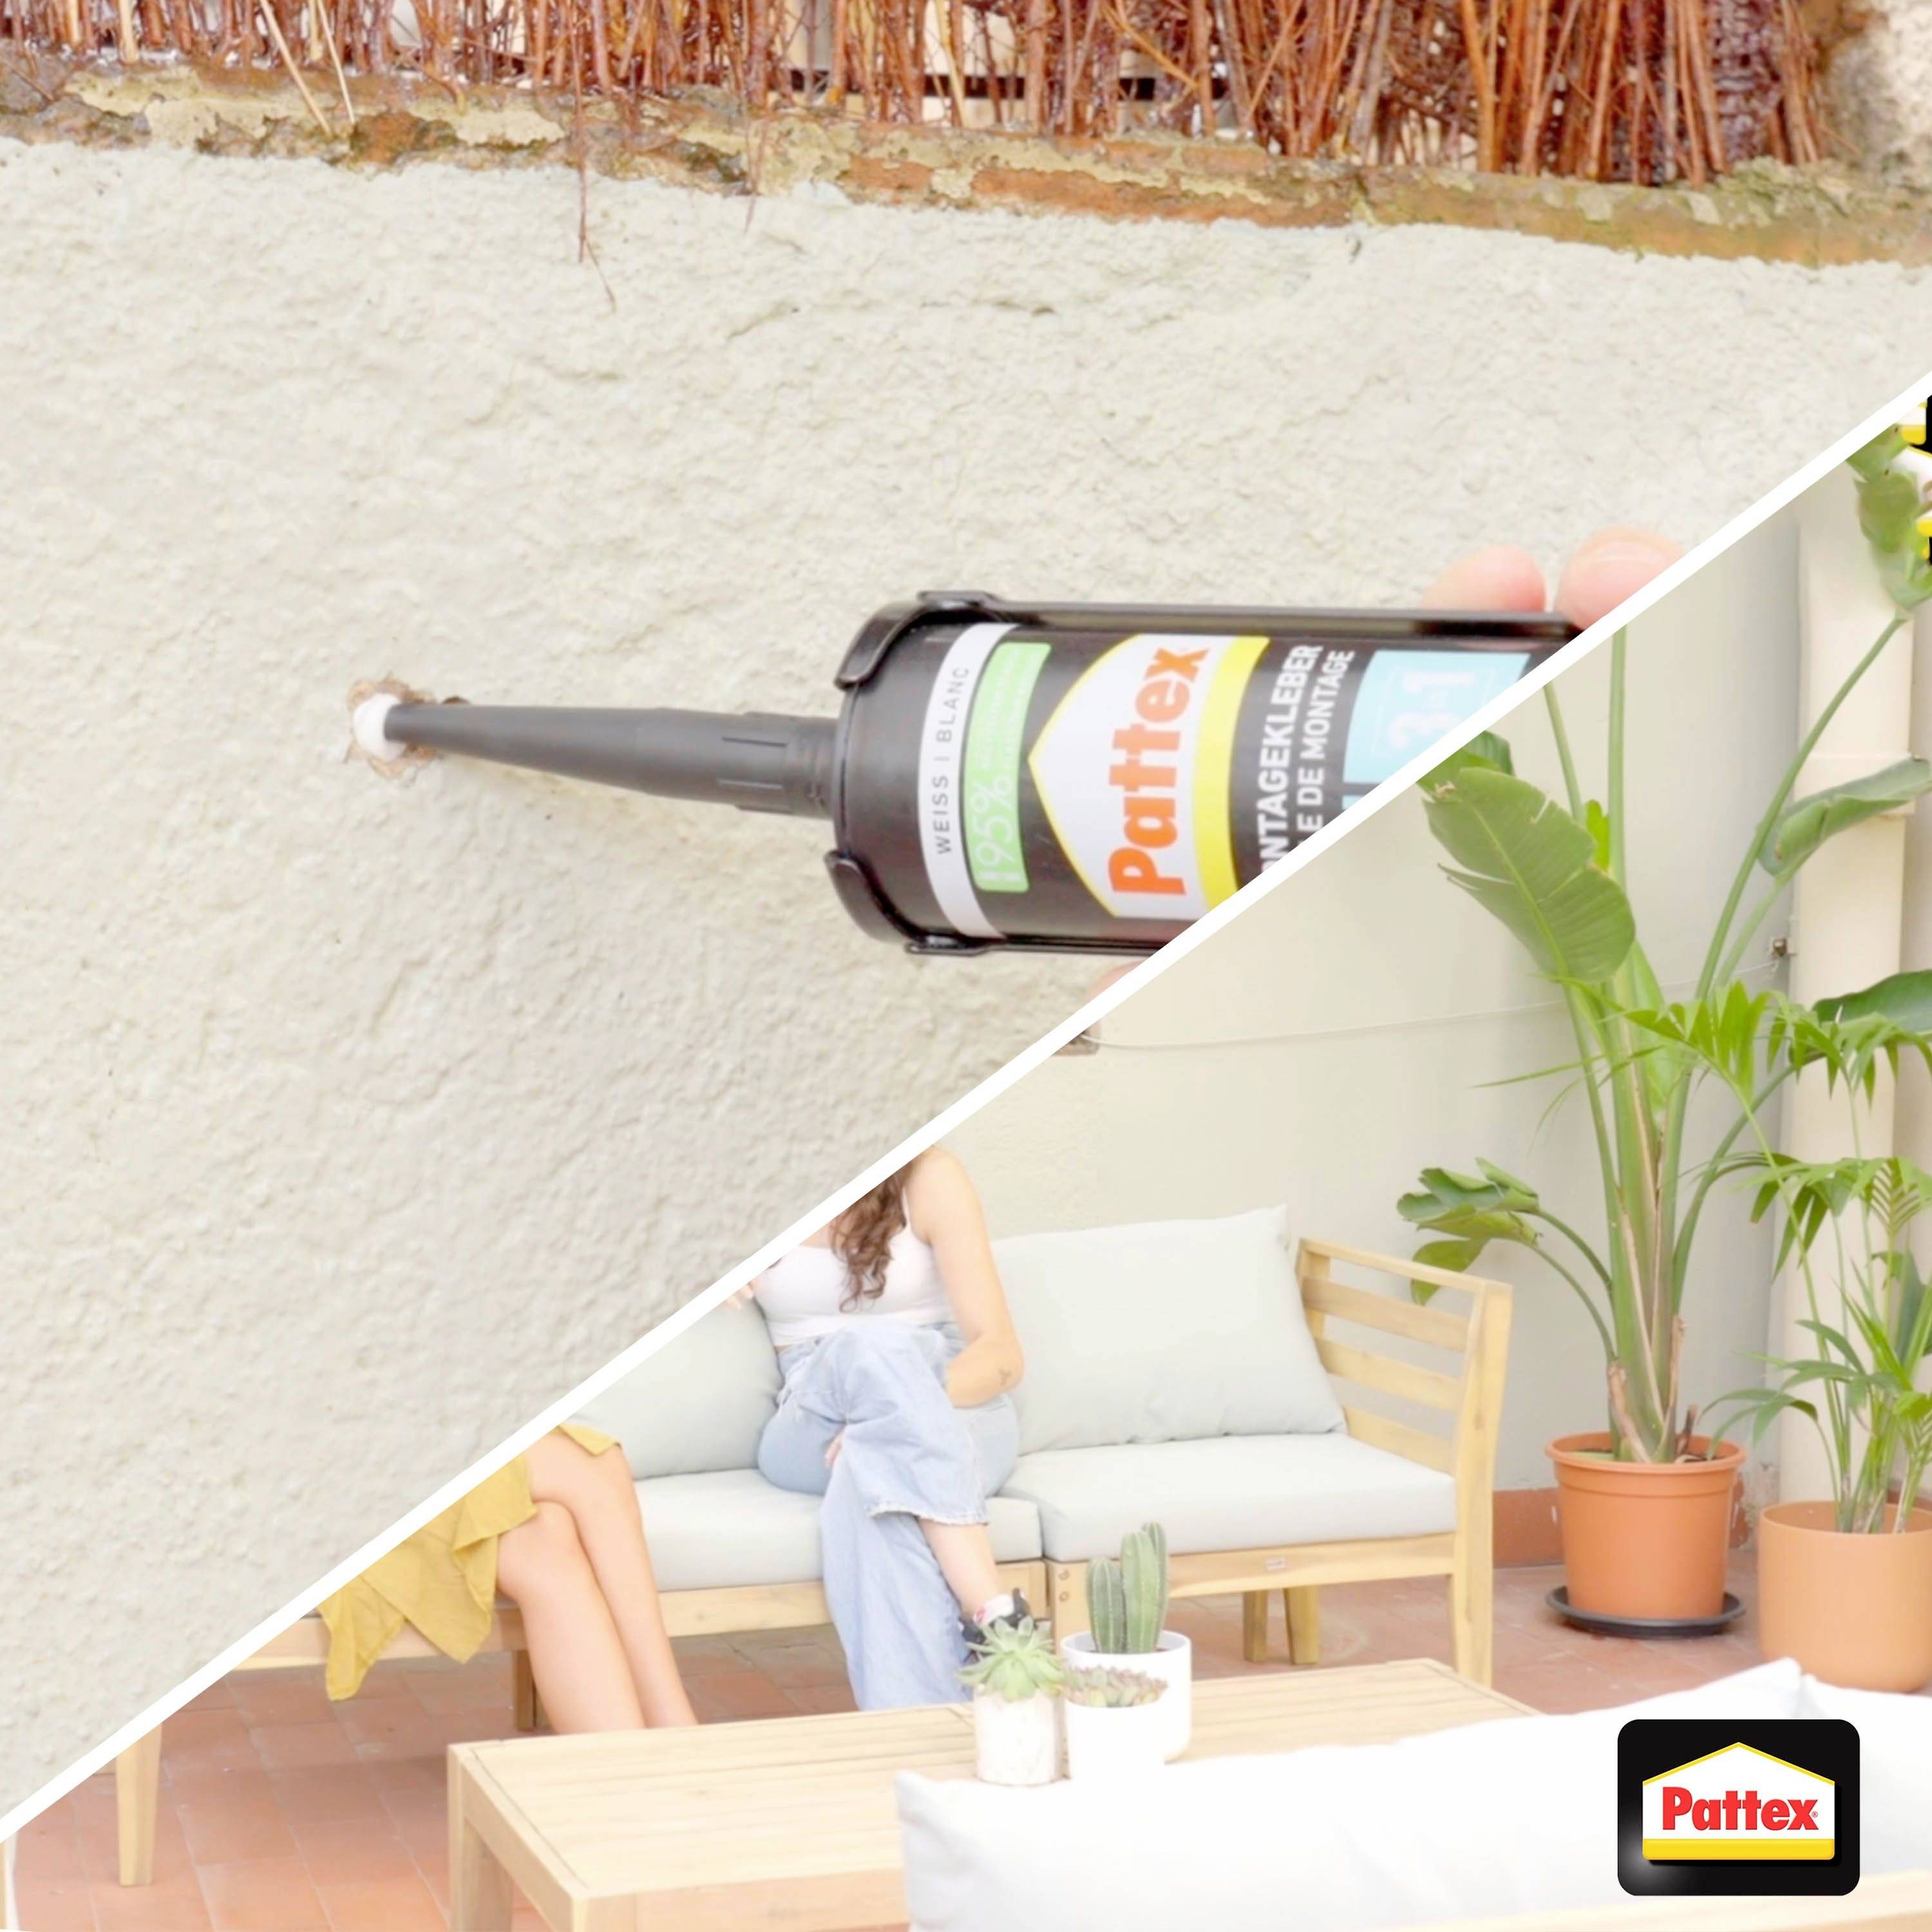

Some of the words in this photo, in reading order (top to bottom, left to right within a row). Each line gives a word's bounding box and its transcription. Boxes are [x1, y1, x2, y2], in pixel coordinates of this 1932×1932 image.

[937, 667, 969, 742] BLANC
[1300, 650, 1355, 764] MONTAGE
[1108, 647, 1209, 896] Pattex
[1297, 768, 1324, 806] DE
[932, 775, 951, 854] WEISS
[969, 775, 1016, 864] 95%
